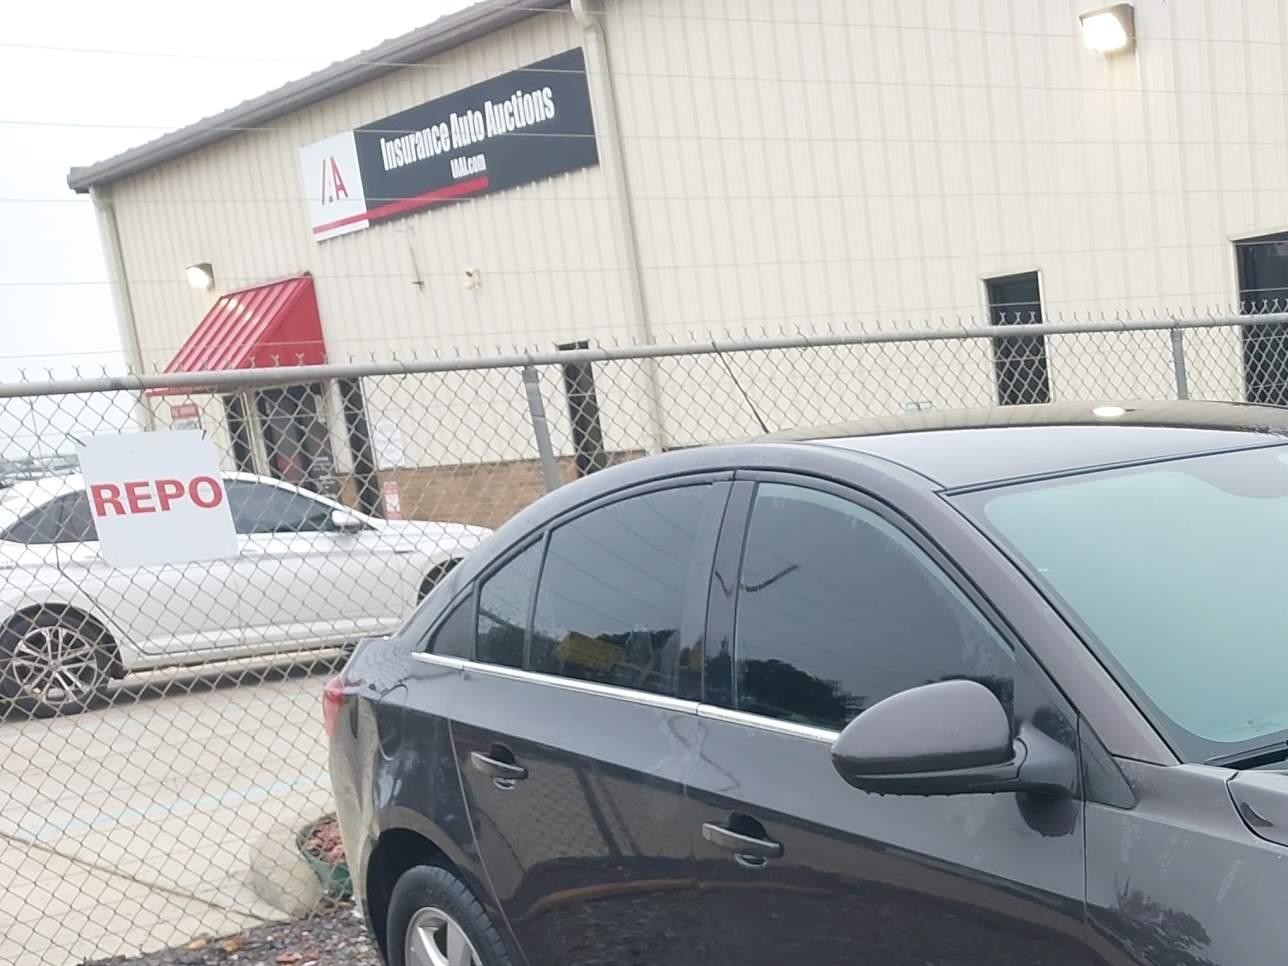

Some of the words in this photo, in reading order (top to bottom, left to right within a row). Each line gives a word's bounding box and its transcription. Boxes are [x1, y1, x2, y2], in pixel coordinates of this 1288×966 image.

[380, 121, 450, 171] Insurance
[450, 109, 485, 149] Auto
[484, 86, 555, 138] Auctions
[90, 475, 223, 517] REPO
